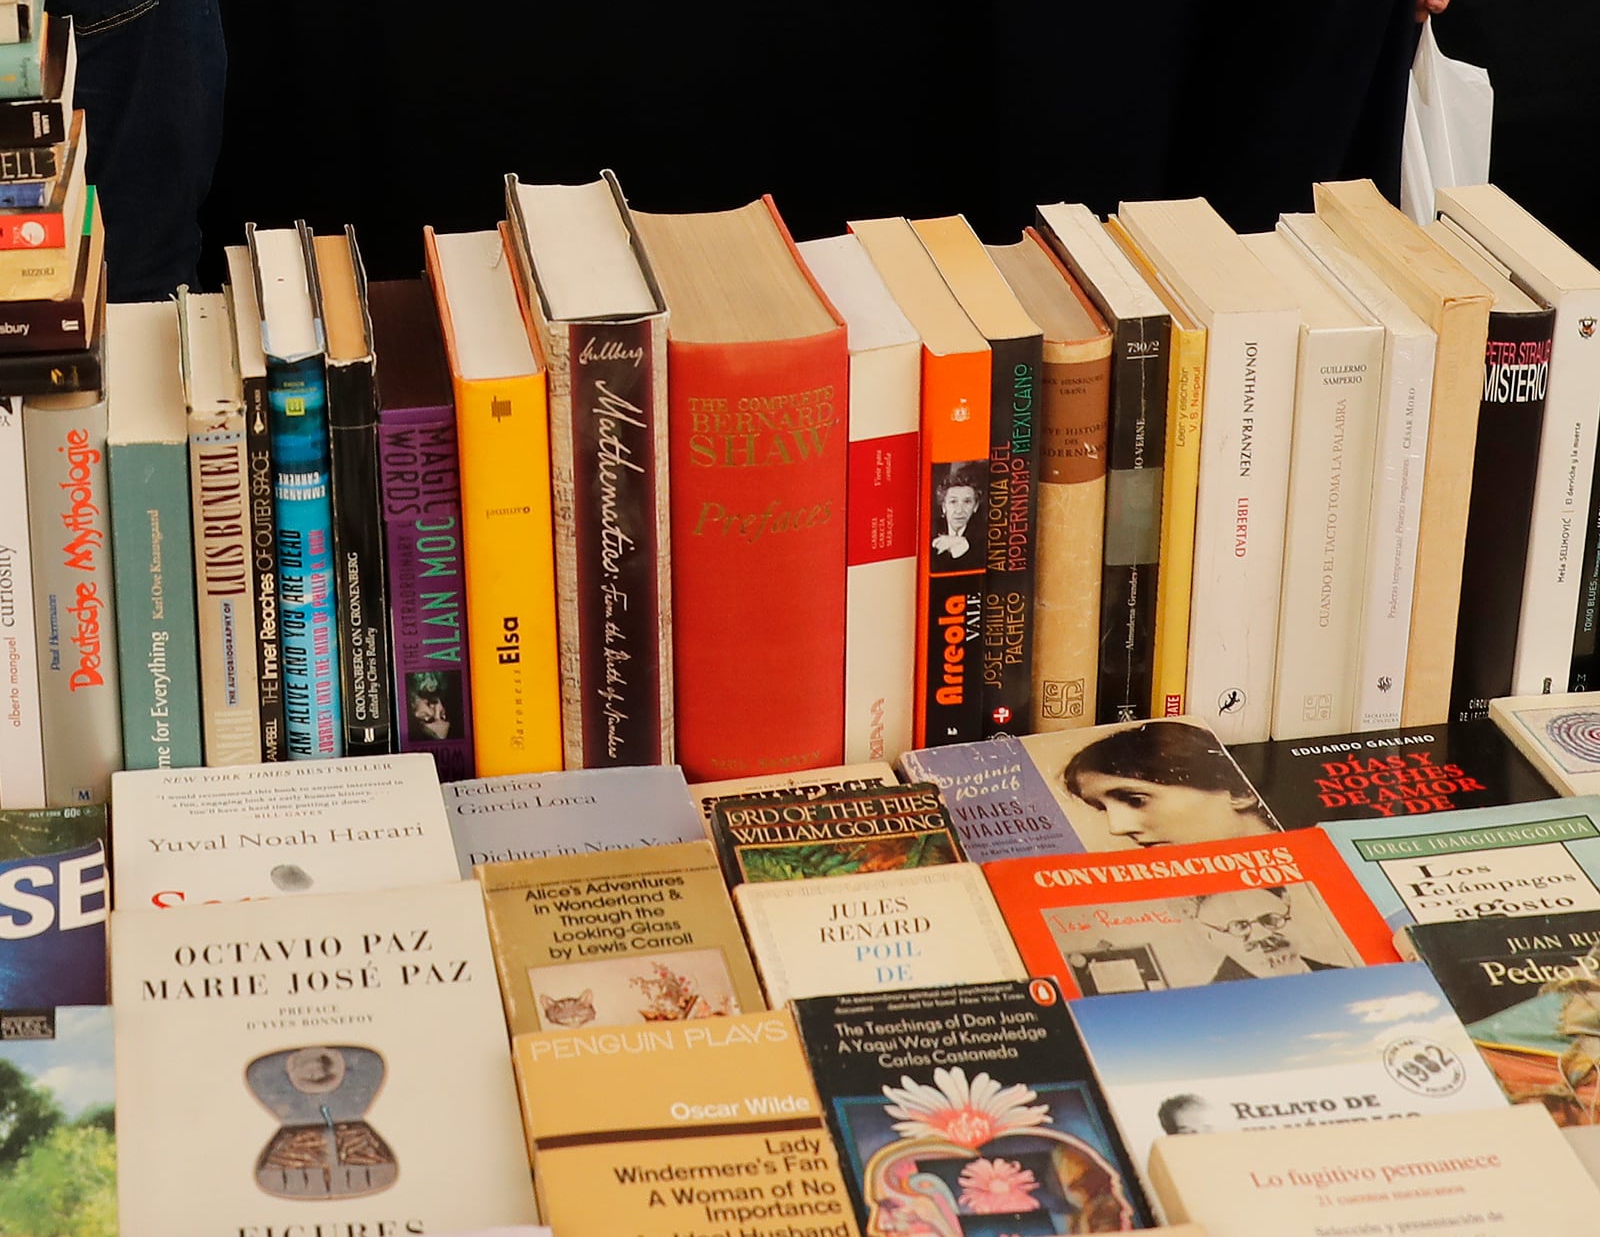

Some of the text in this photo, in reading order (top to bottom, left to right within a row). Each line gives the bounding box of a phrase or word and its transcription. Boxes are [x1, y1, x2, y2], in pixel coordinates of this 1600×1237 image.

[691, 401, 838, 433] BERNARD
[1240, 340, 1258, 477] JONATHAN FRANZEN
[688, 422, 828, 468] SHAW
[1234, 498, 1249, 558] LIBERTAD
[59, 427, 105, 691] Deutsche Mythologie
[496, 616, 519, 665] Elsa
[935, 593, 966, 705] Arreola
[1291, 733, 1435, 758] EDUARDO GALEANO
[725, 793, 941, 827] LORD OF THE FLIES
[148, 822, 424, 854] Yuval Noah Harari
[731, 813, 945, 845] WILLIAM GOLDING
[1034, 846, 1294, 889] CONVERSACIONES
[1239, 862, 1304, 888] CON
[829, 897, 910, 922] JULES
[819, 916, 931, 943] RENARD
[174, 929, 433, 968] OCTAVIO PAZ
[856, 941, 921, 963] POIL
[876, 965, 914, 984] DE
[878, 1043, 1019, 1070] Carlos Castaneda
[670, 1093, 810, 1122] Oscar Wilde
